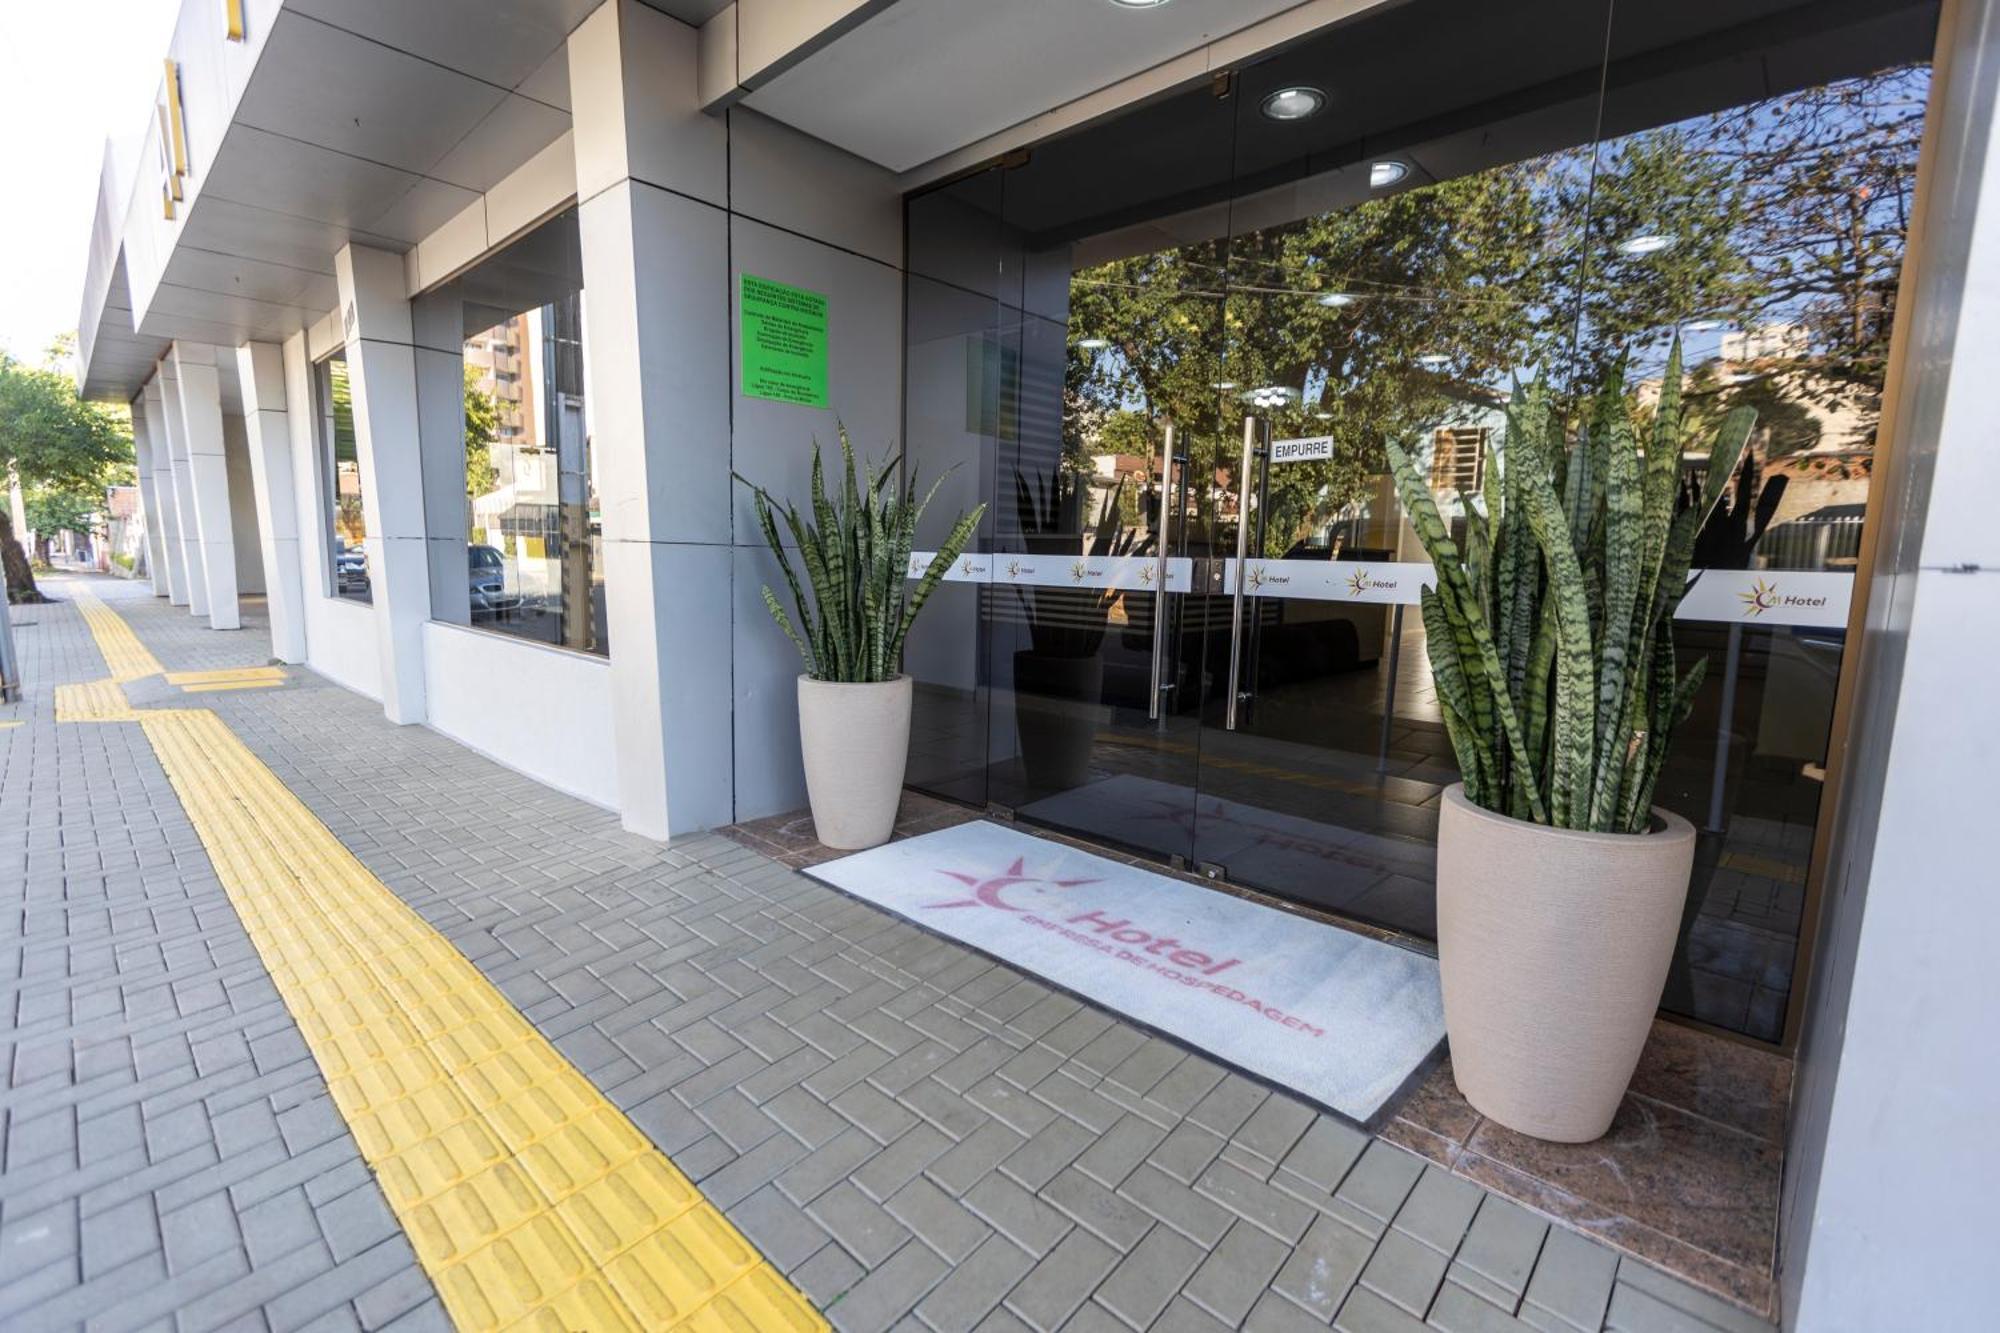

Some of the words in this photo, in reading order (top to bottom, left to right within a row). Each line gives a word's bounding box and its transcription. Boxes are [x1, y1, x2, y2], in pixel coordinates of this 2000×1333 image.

[1275, 441, 1328, 458] EMPURRE
[1269, 576, 1290, 585] Hotel
[1373, 580, 1398, 588] Hotel
[1784, 596, 1827, 606] Hotel
[1066, 911, 1243, 976] Hotel
[1115, 949, 1151, 966] DE
[1148, 962, 1325, 1038] HOSPEDAGEM
